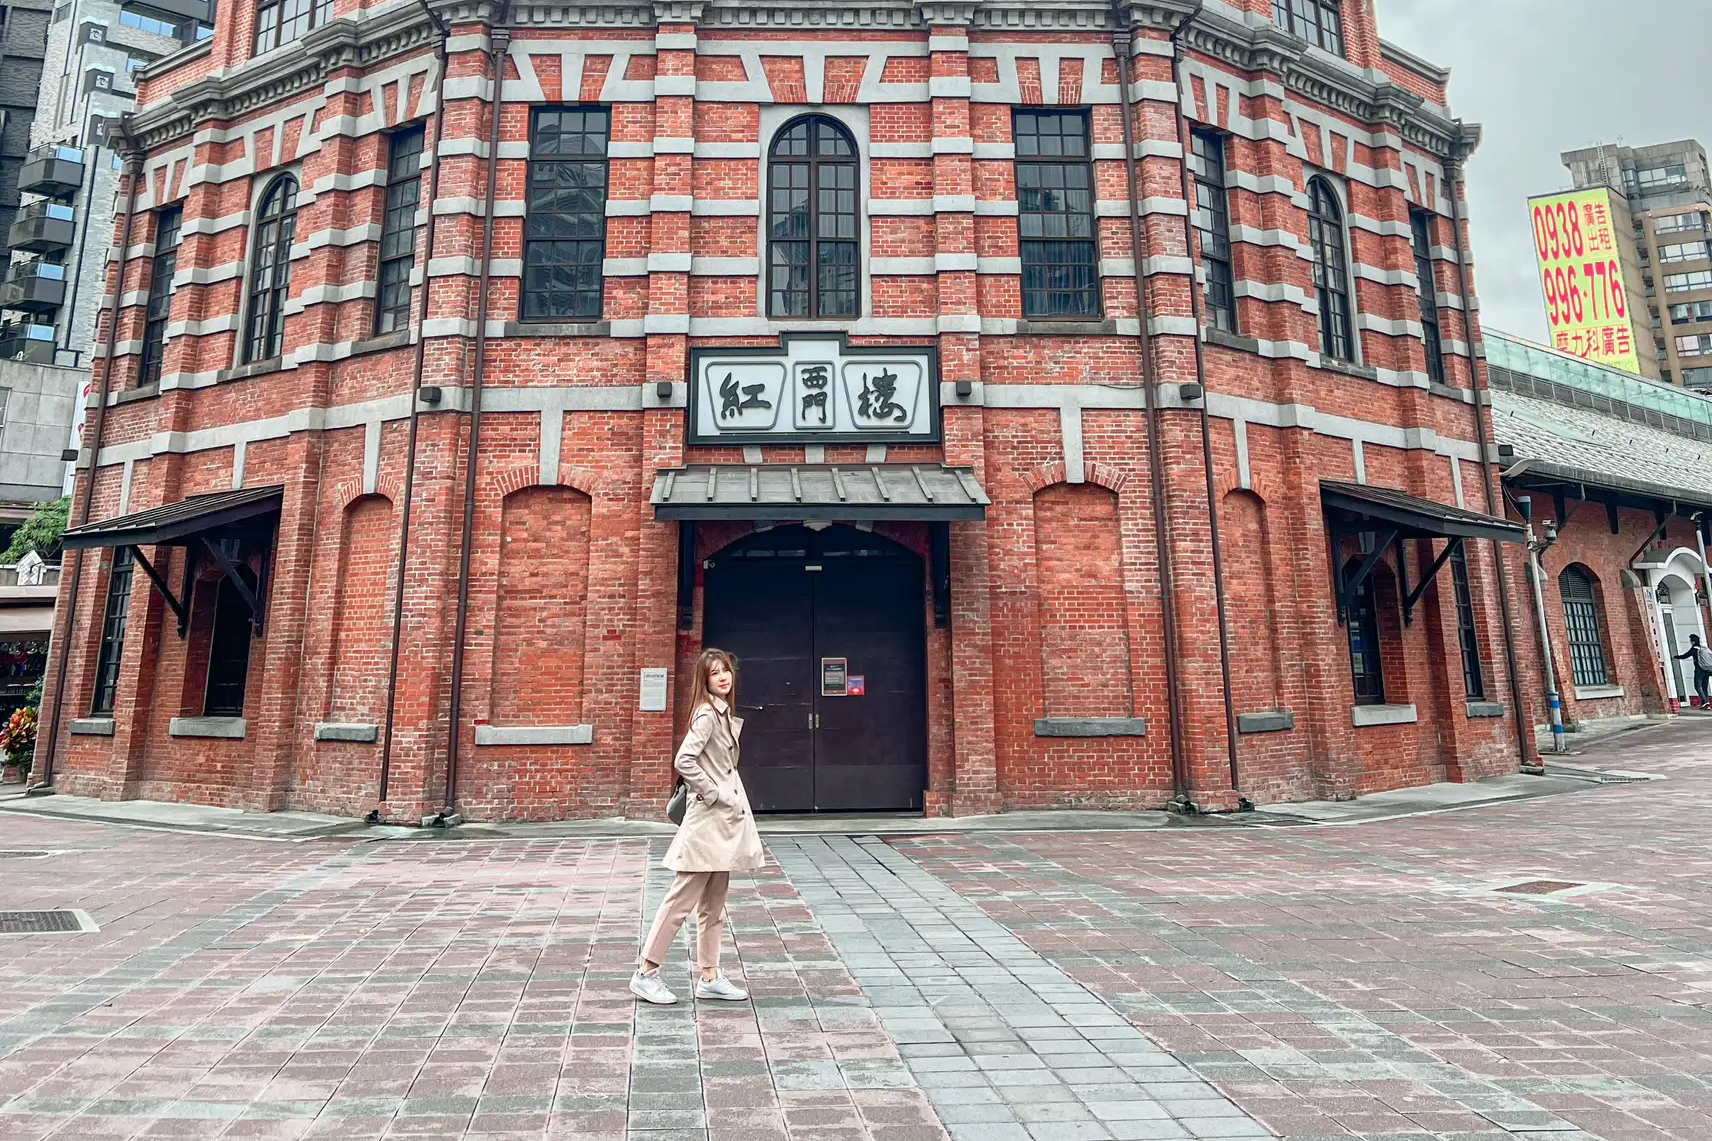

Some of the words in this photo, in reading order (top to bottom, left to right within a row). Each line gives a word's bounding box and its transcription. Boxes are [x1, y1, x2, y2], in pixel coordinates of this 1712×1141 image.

[1583, 202, 1607, 227] 廣告
[1533, 200, 1584, 262] 0938
[1588, 228, 1612, 252] 出租
